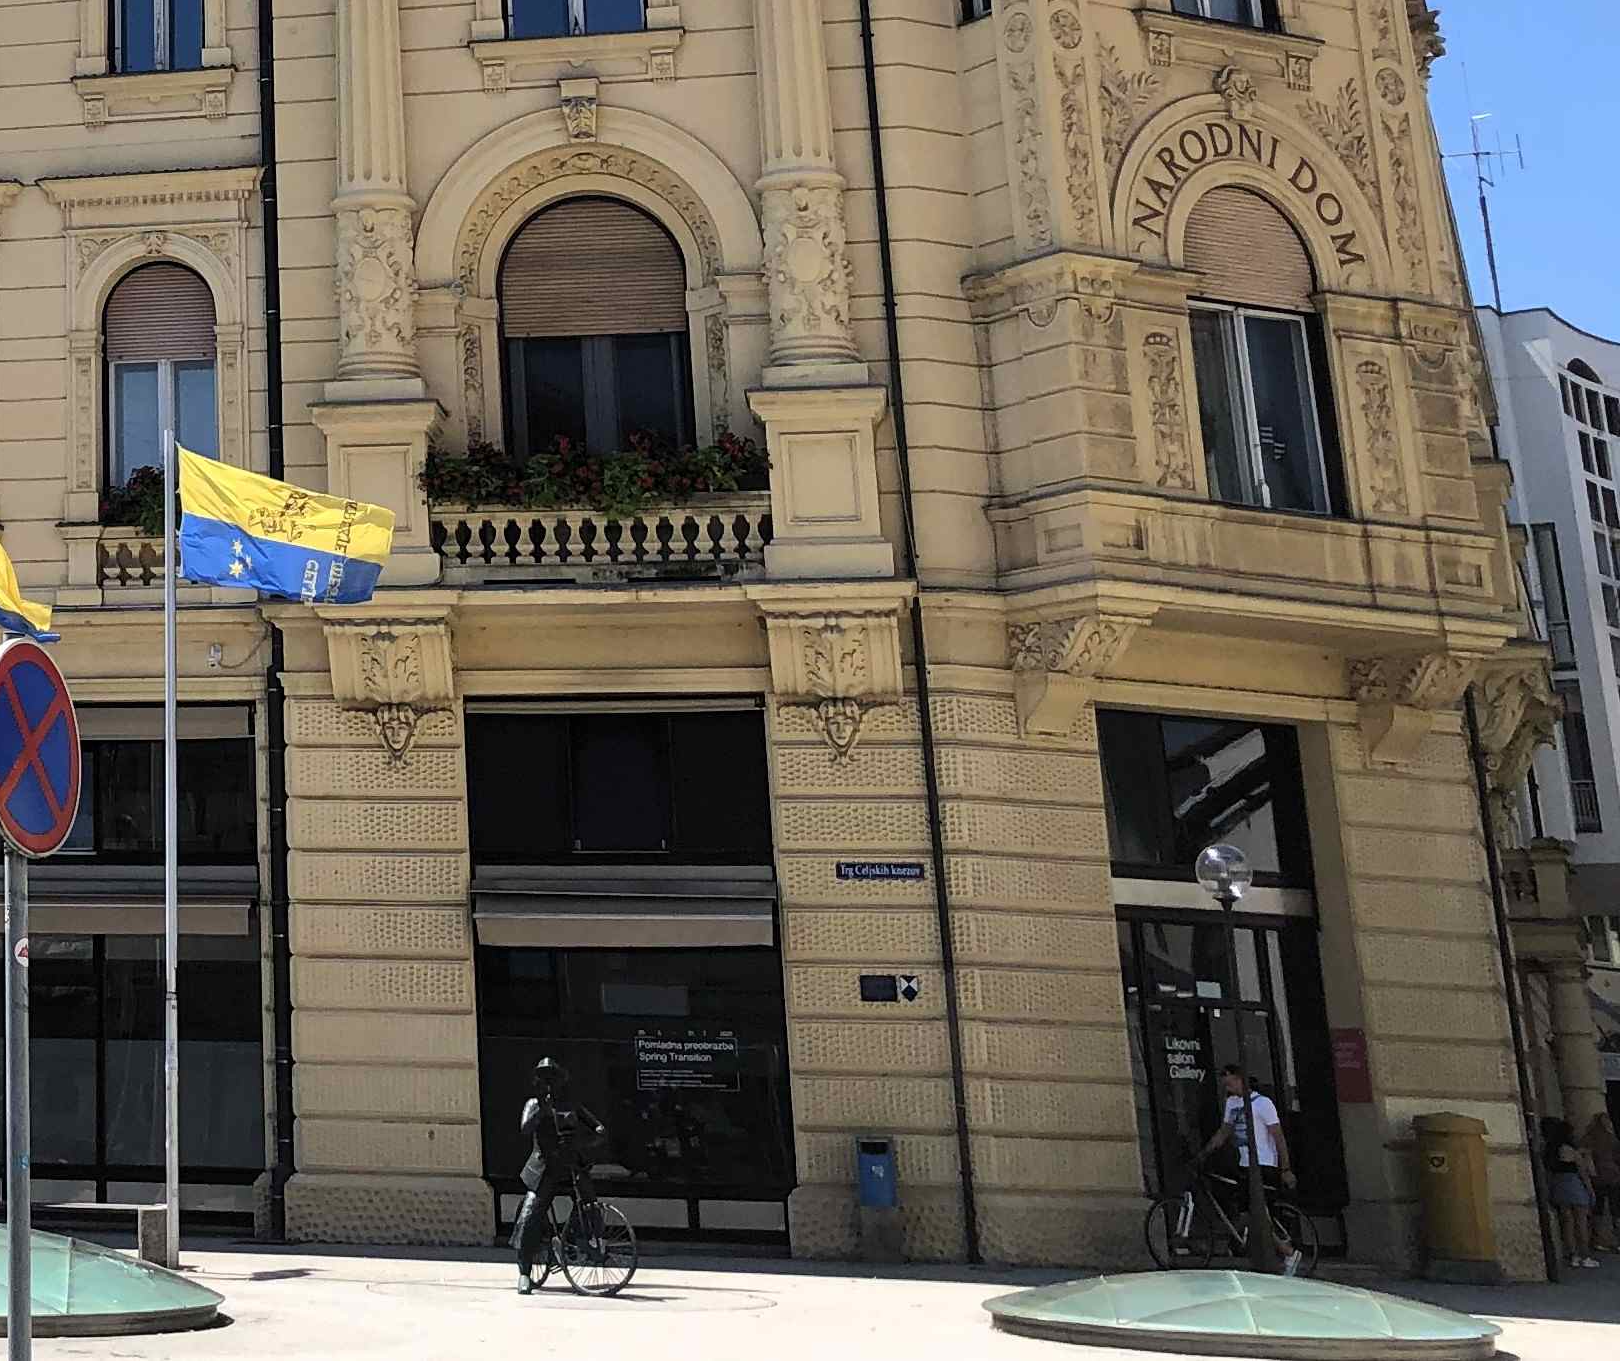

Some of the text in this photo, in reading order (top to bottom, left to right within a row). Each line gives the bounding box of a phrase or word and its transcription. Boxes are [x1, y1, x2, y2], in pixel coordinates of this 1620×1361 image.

[1132, 122, 1366, 269] NARODNI DOM
[841, 864, 854, 878] Trg
[1165, 1036, 1201, 1051] Likovni
[639, 1051, 712, 1063] Spring Transition
[1167, 1051, 1196, 1065] salon
[1170, 1065, 1206, 1082] Gallery
